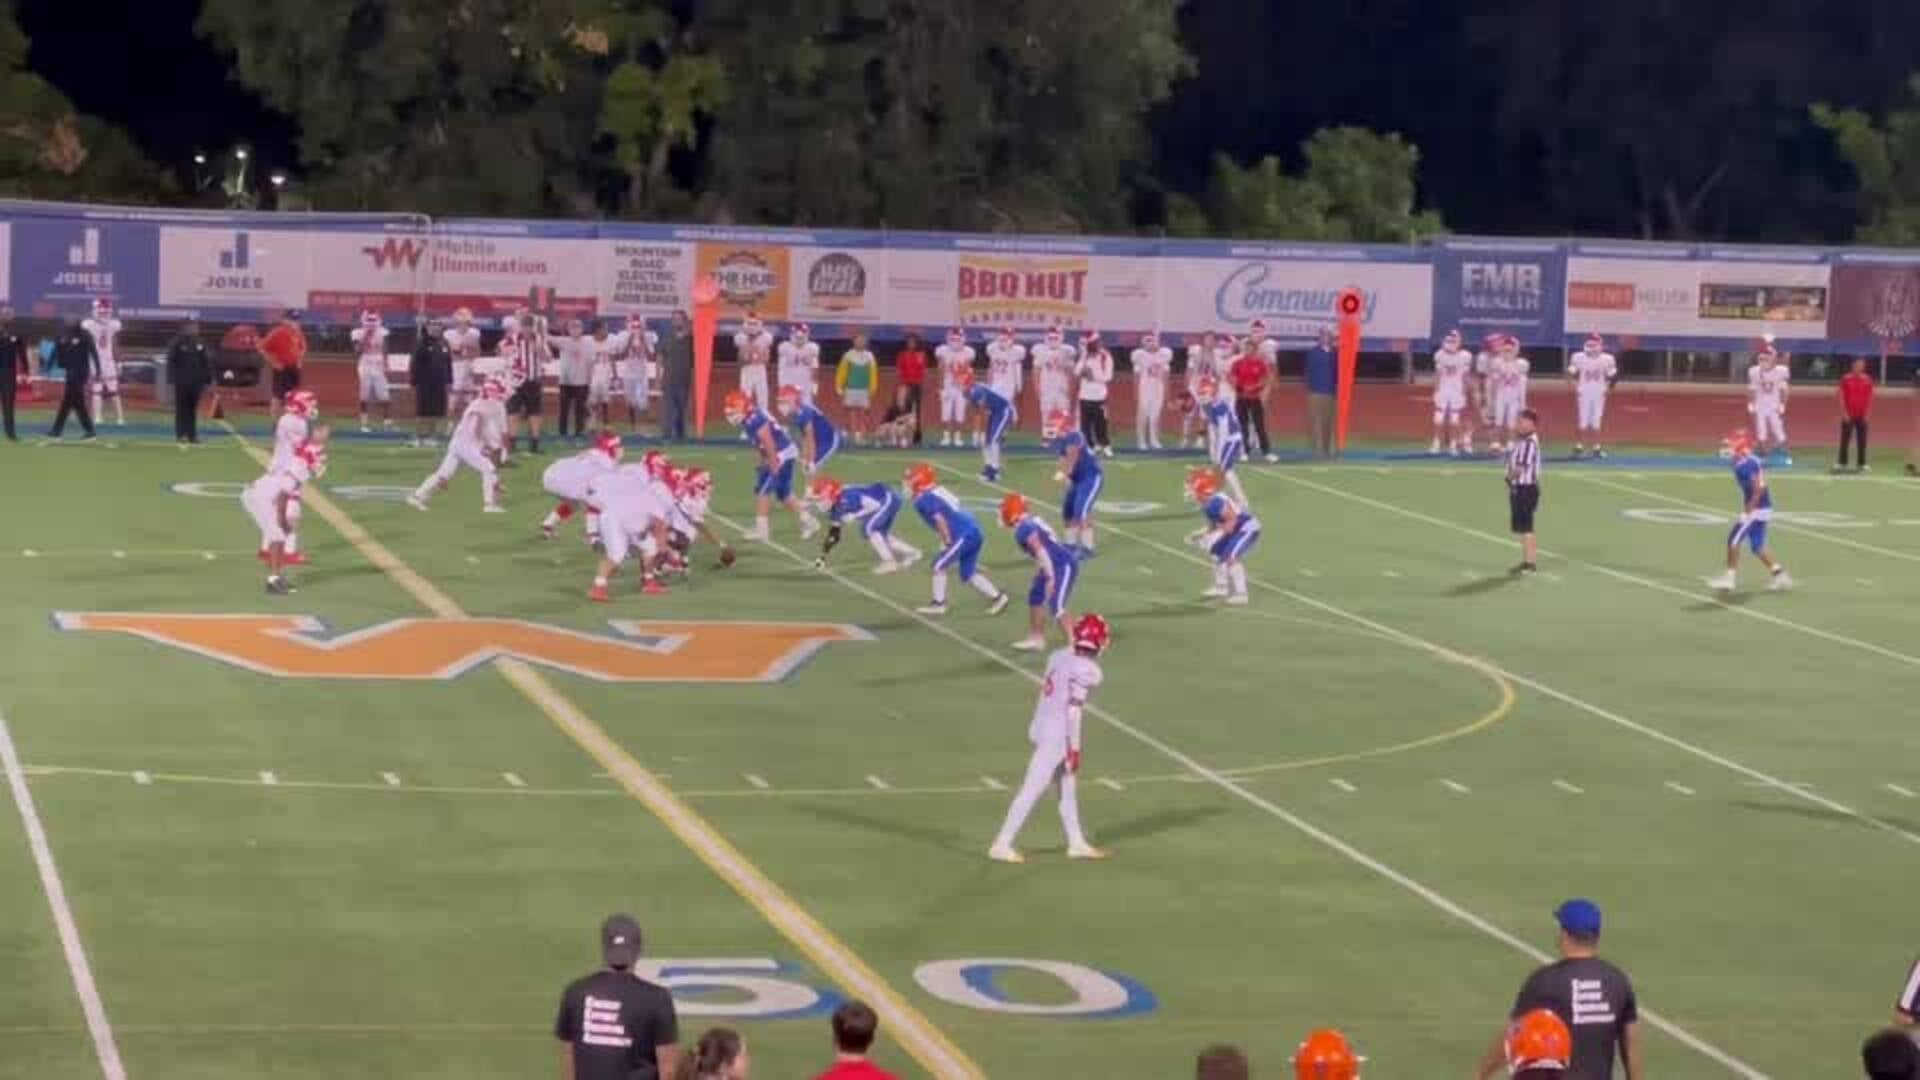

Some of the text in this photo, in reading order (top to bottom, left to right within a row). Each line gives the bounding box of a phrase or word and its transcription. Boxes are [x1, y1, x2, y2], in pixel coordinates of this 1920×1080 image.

[432, 256, 547, 273] Illumination
[204, 275, 263, 289] JONES
[958, 265, 1020, 299] BBQ
[1024, 270, 1089, 304] HUT
